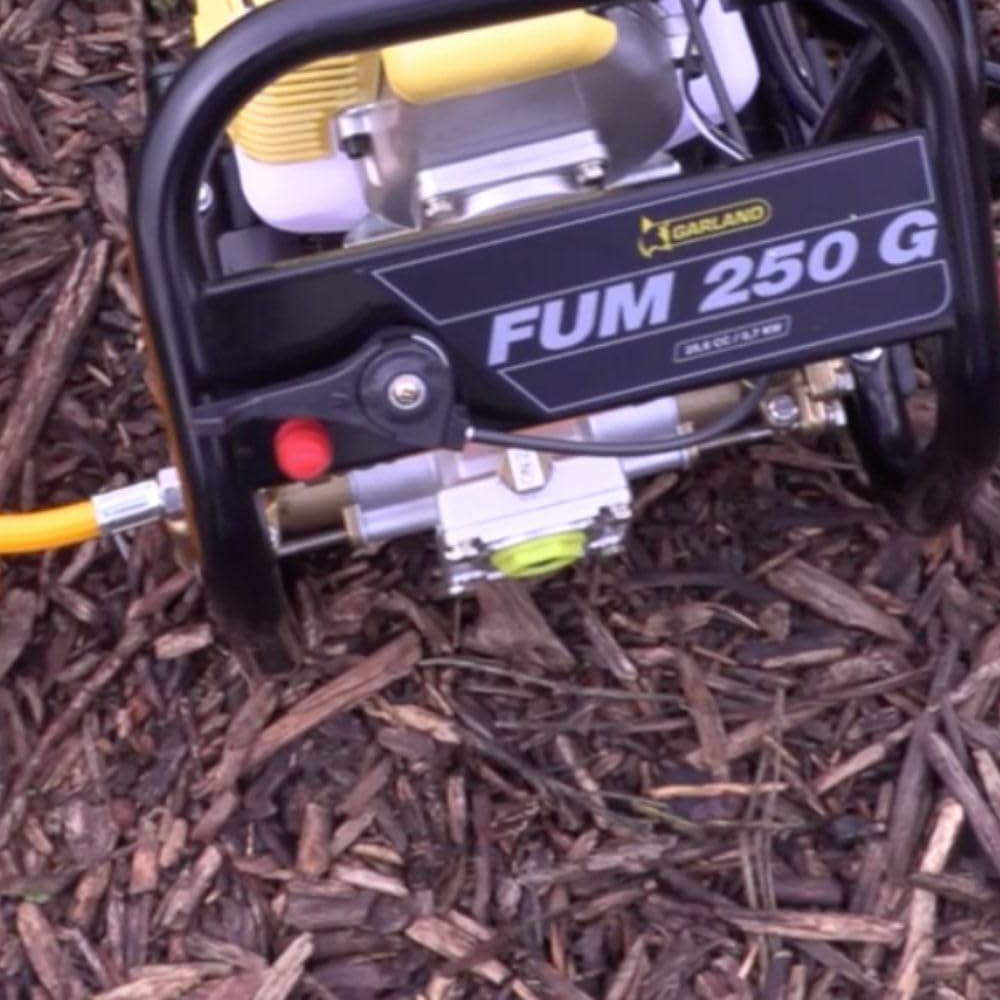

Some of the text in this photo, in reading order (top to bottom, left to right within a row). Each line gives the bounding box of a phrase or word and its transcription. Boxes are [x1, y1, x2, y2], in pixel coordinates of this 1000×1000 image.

[672, 205, 764, 240] GARLAND
[487, 209, 938, 367] FUM 250 G
